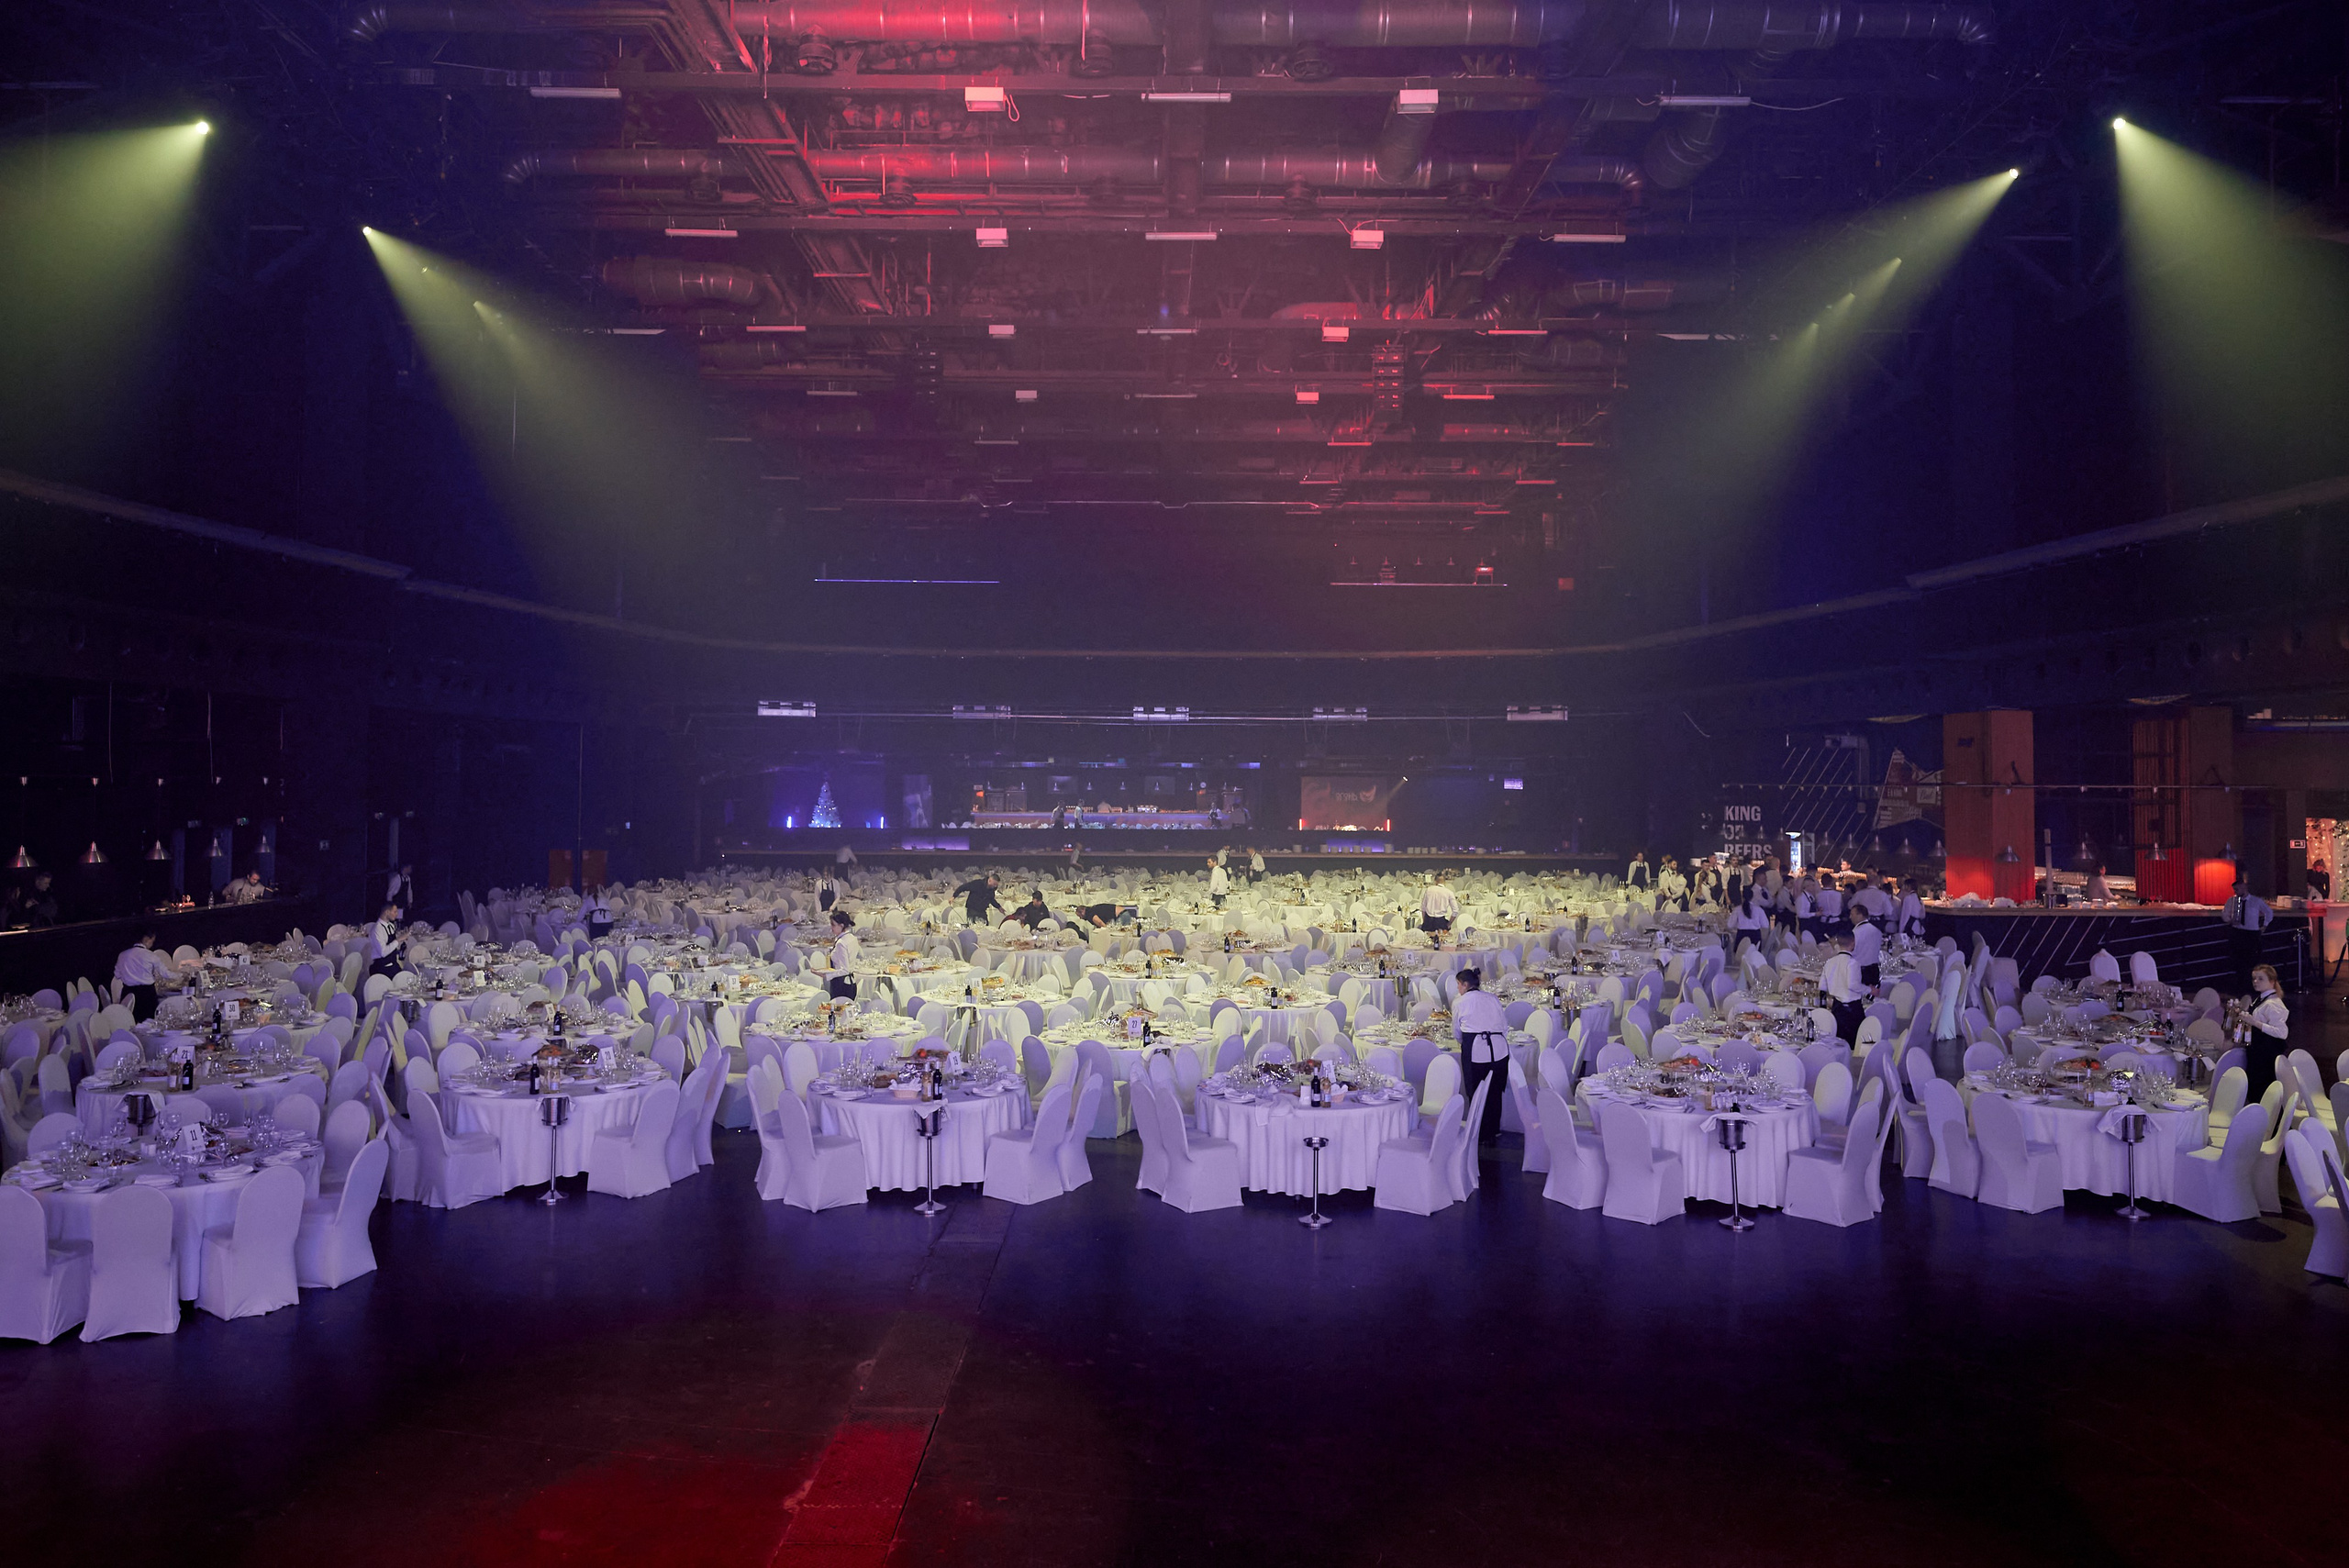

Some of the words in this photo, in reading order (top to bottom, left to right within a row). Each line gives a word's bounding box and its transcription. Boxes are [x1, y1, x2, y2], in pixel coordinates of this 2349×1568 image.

[1724, 806, 1761, 821] KING
[228, 1004, 236, 1013] 30
[1131, 1019, 1138, 1029] 27
[181, 1049, 188, 1059] 21
[604, 1051, 612, 1060] 20
[190, 1129, 198, 1140] 11
